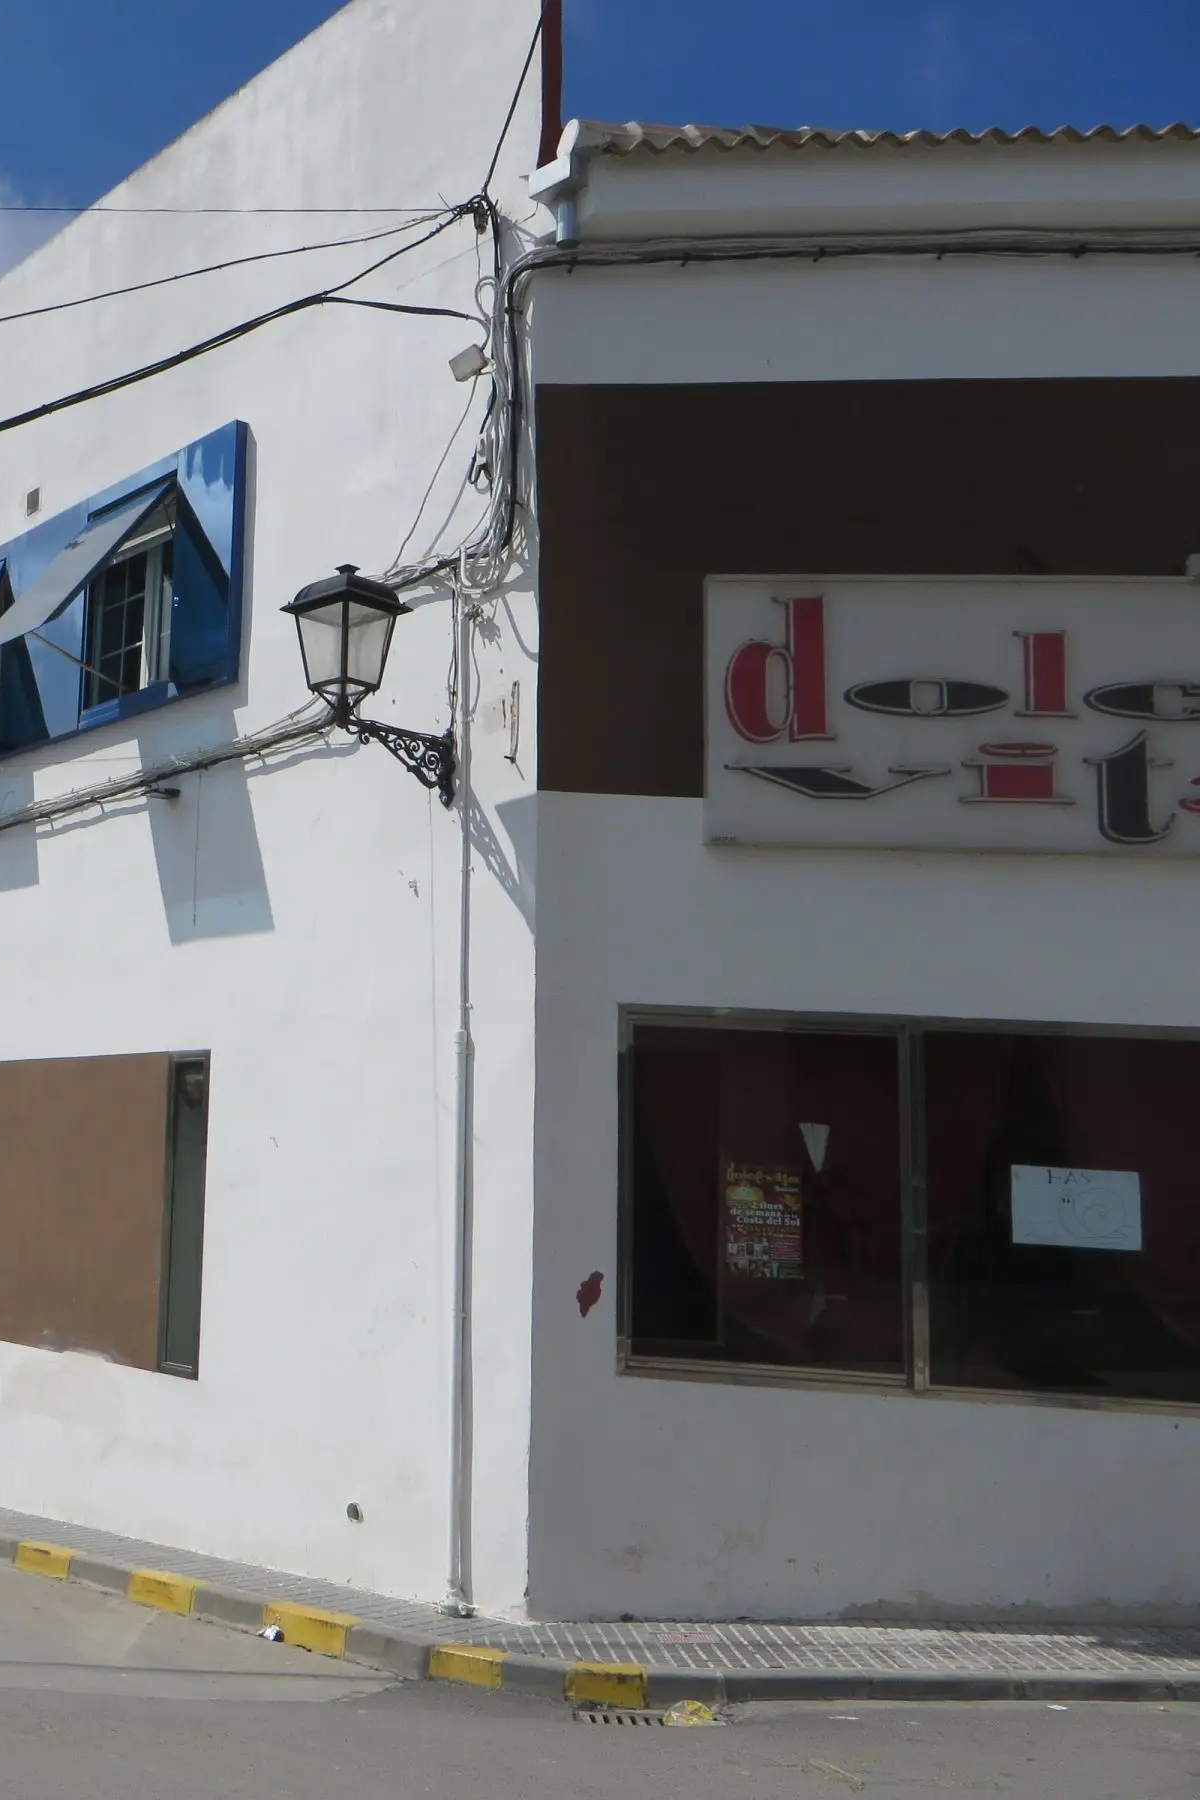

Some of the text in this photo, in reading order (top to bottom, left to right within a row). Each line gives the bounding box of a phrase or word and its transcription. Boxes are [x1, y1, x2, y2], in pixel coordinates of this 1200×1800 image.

[730, 1207, 743, 1216] de
[745, 1209, 782, 1218] semana
[737, 1216, 800, 1227] Costa del Sol
